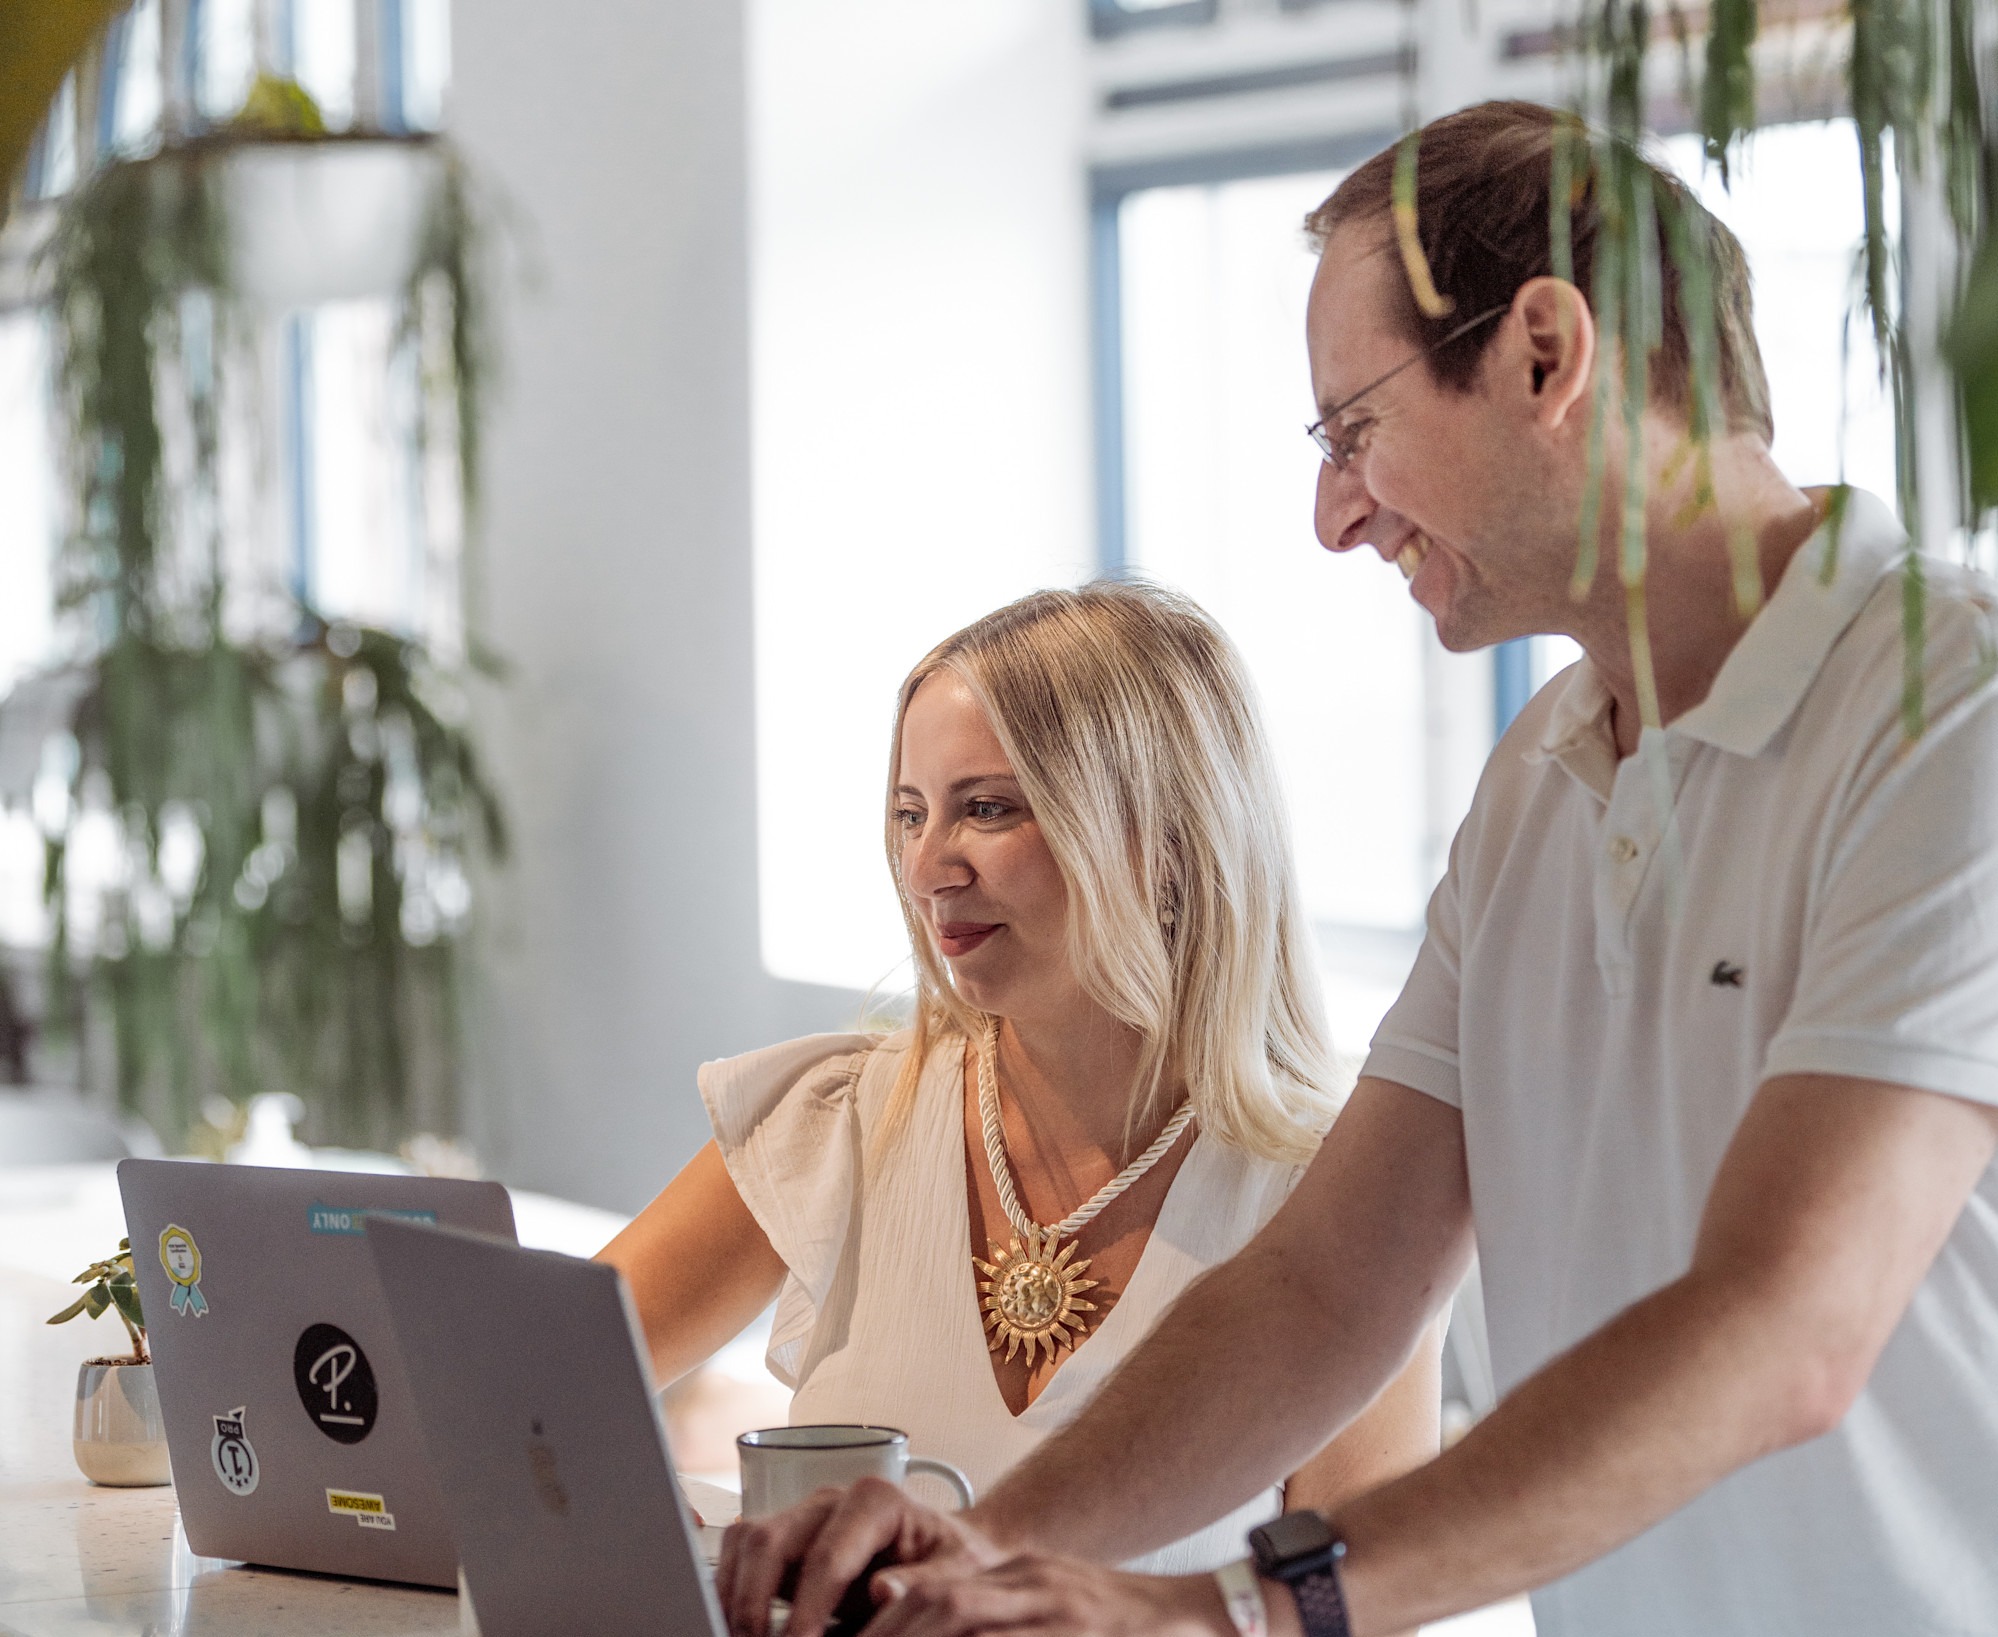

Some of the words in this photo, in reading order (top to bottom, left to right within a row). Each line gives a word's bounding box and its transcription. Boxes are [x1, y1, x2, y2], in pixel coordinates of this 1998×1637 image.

[313, 1212, 351, 1230] ONLY
[221, 1423, 240, 1435] PRO
[227, 1446, 243, 1476] 1
[330, 1496, 381, 1512] AWESOME
[360, 1514, 374, 1523] ARE
[376, 1516, 392, 1526] YOU
